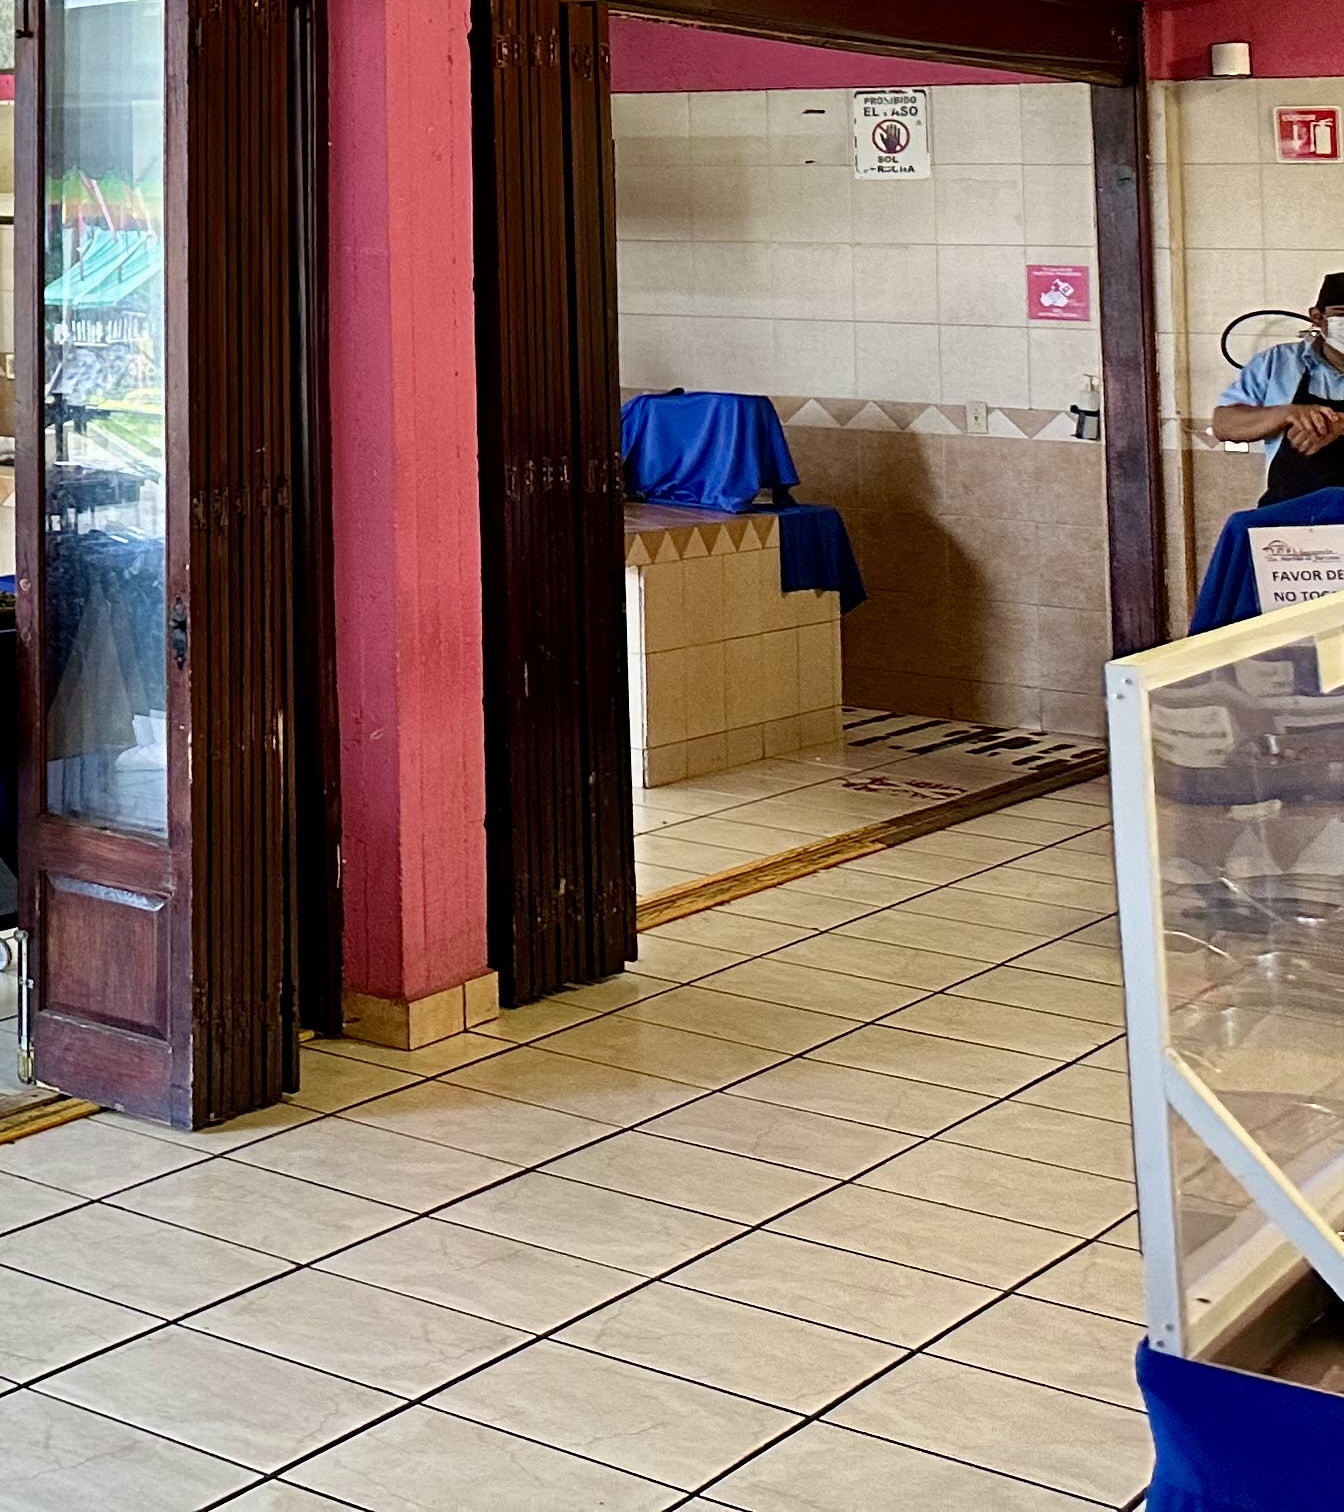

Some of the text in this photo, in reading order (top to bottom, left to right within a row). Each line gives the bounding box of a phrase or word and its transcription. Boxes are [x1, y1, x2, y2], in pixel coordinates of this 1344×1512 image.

[863, 105, 919, 117] EL ASO
[1272, 570, 1323, 582] FAVOR
[1274, 590, 1338, 602] NO TO
